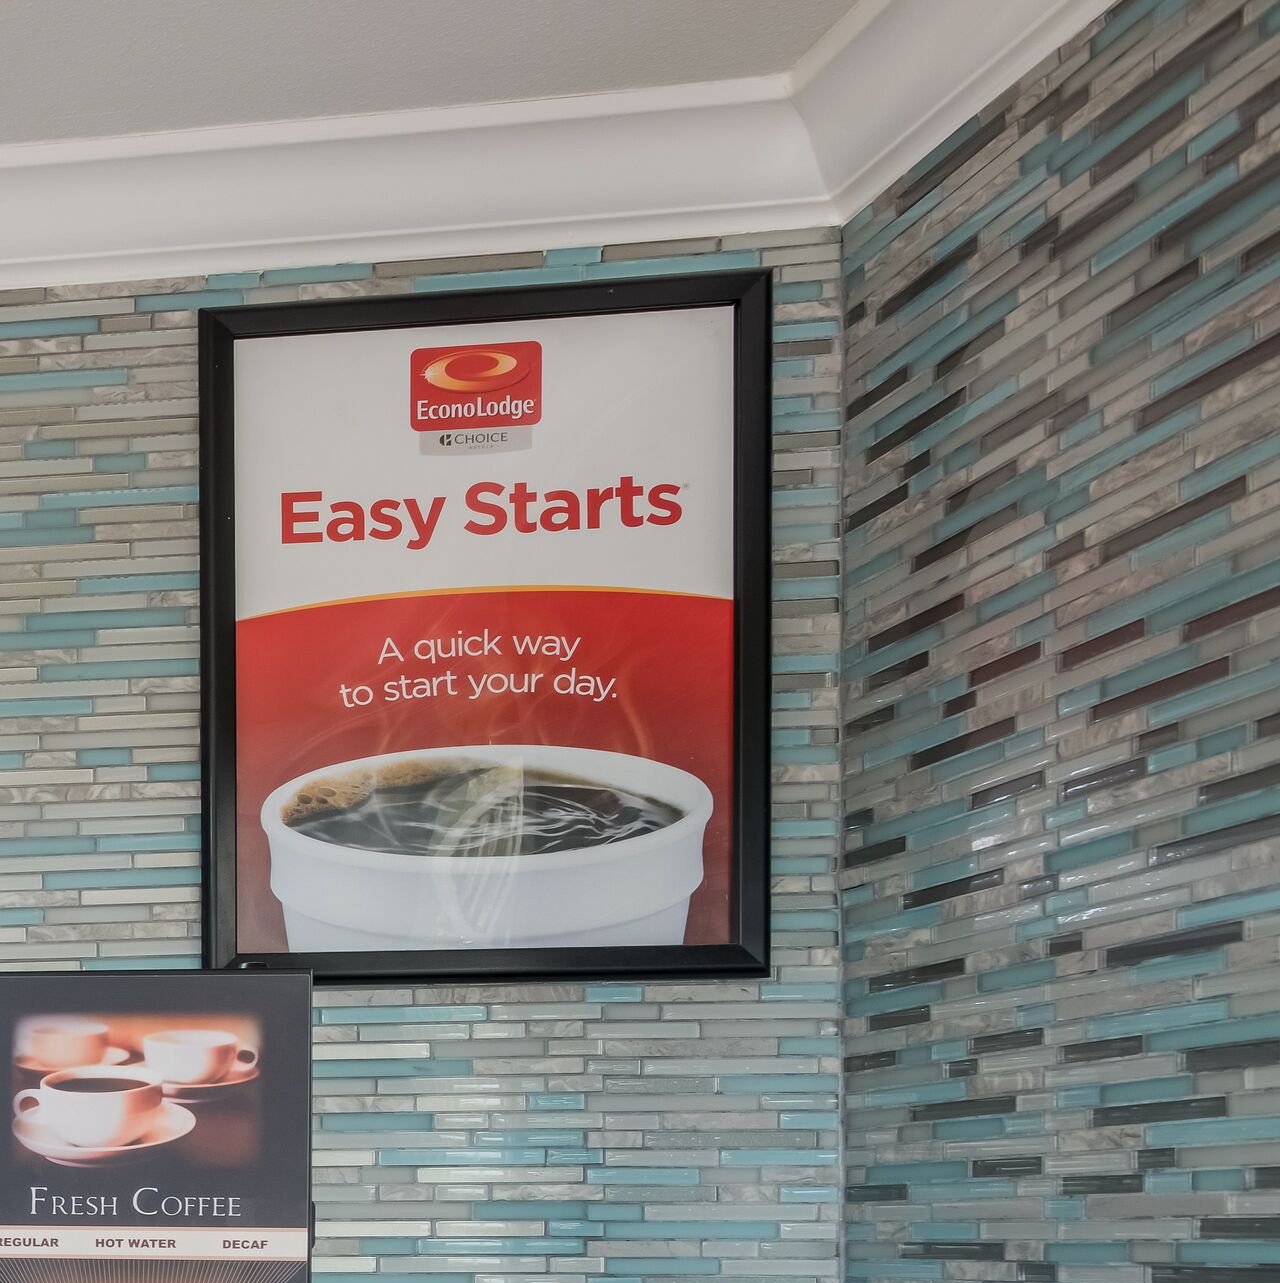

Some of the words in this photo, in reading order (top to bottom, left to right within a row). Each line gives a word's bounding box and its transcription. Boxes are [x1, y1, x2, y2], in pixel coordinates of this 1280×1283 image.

[454, 432, 509, 445] CHOICE
[281, 490, 447, 551] Easy
[463, 476, 682, 536] Starts
[377, 637, 405, 664] A
[413, 628, 503, 664] quick
[512, 635, 582, 661] way
[339, 683, 374, 708] to
[384, 670, 458, 701] start
[468, 671, 544, 700] your
[553, 667, 618, 702] day.
[95, 1238, 124, 1248] HOT
[128, 1239, 177, 1249] WATER
[222, 1239, 268, 1249] DECAF
